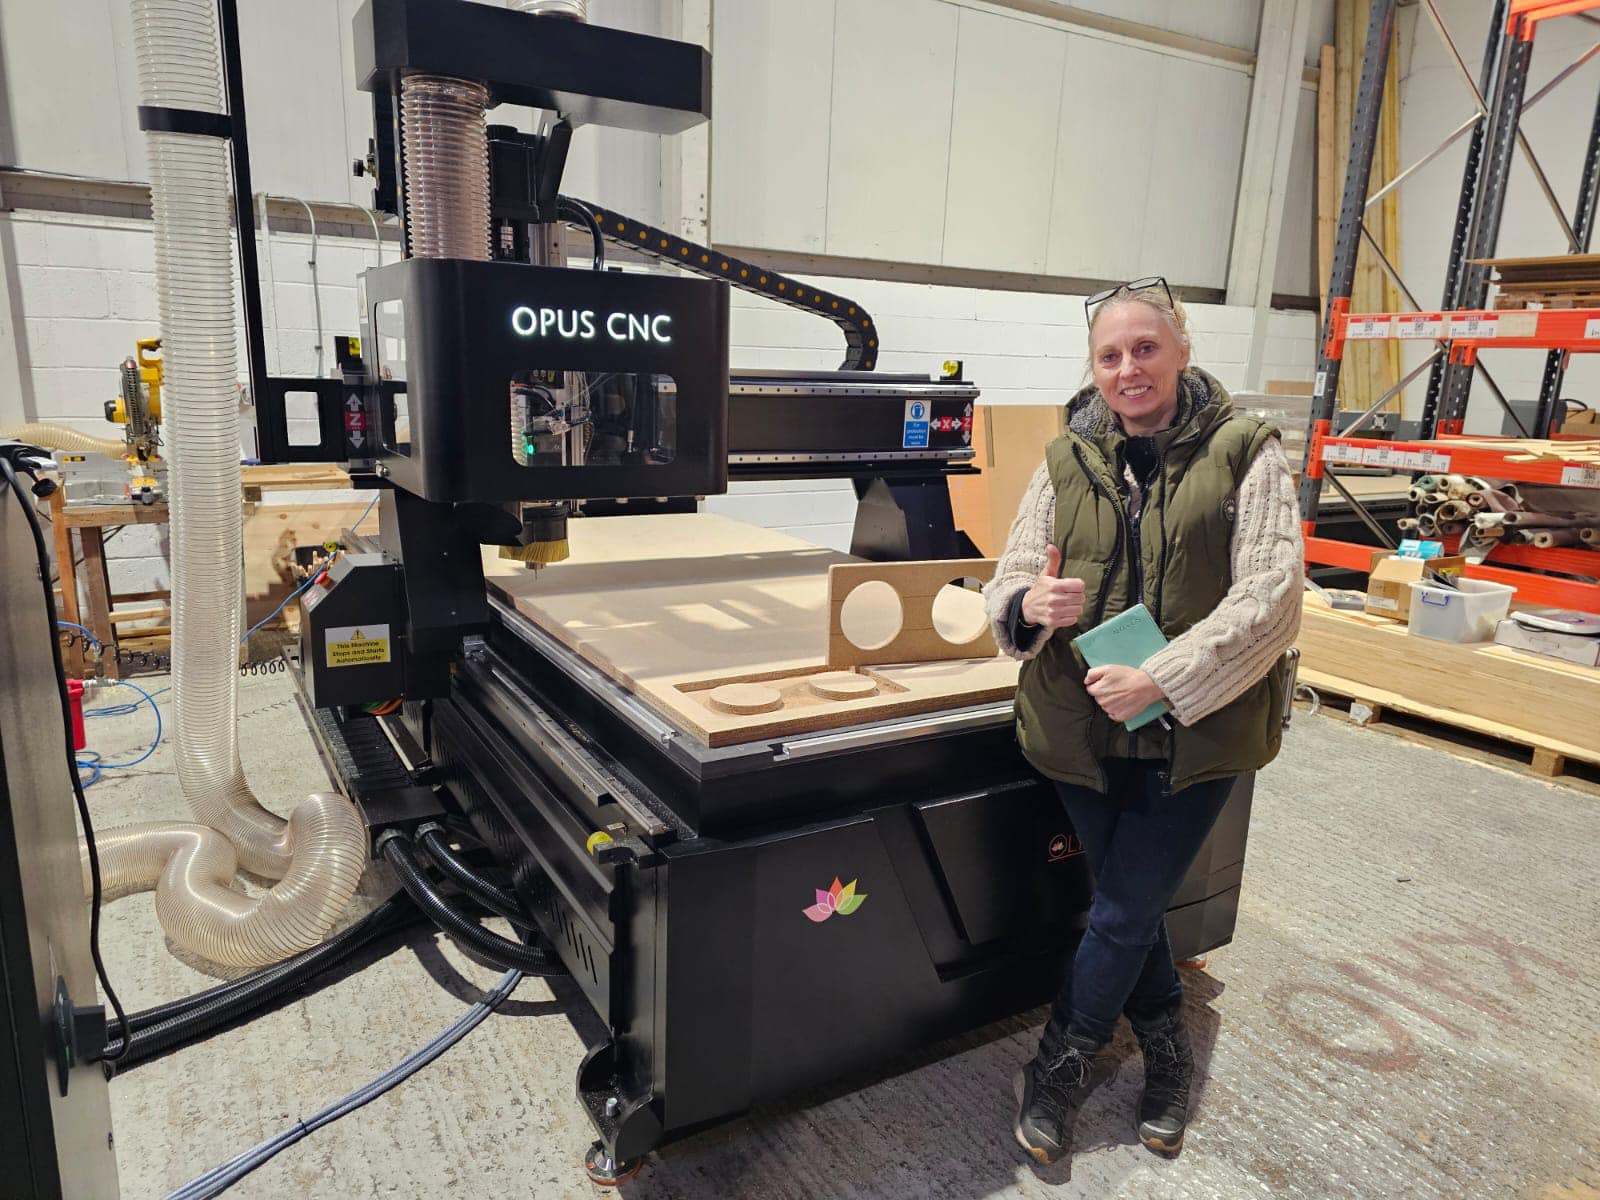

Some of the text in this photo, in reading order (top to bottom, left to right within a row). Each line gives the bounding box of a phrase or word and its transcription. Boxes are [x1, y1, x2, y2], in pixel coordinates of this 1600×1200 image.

[511, 306, 672, 342] OPUS CNC
[350, 413, 361, 426] Z
[942, 419, 951, 429] X
[963, 417, 971, 428] Z
[336, 655, 382, 663] Automatically
